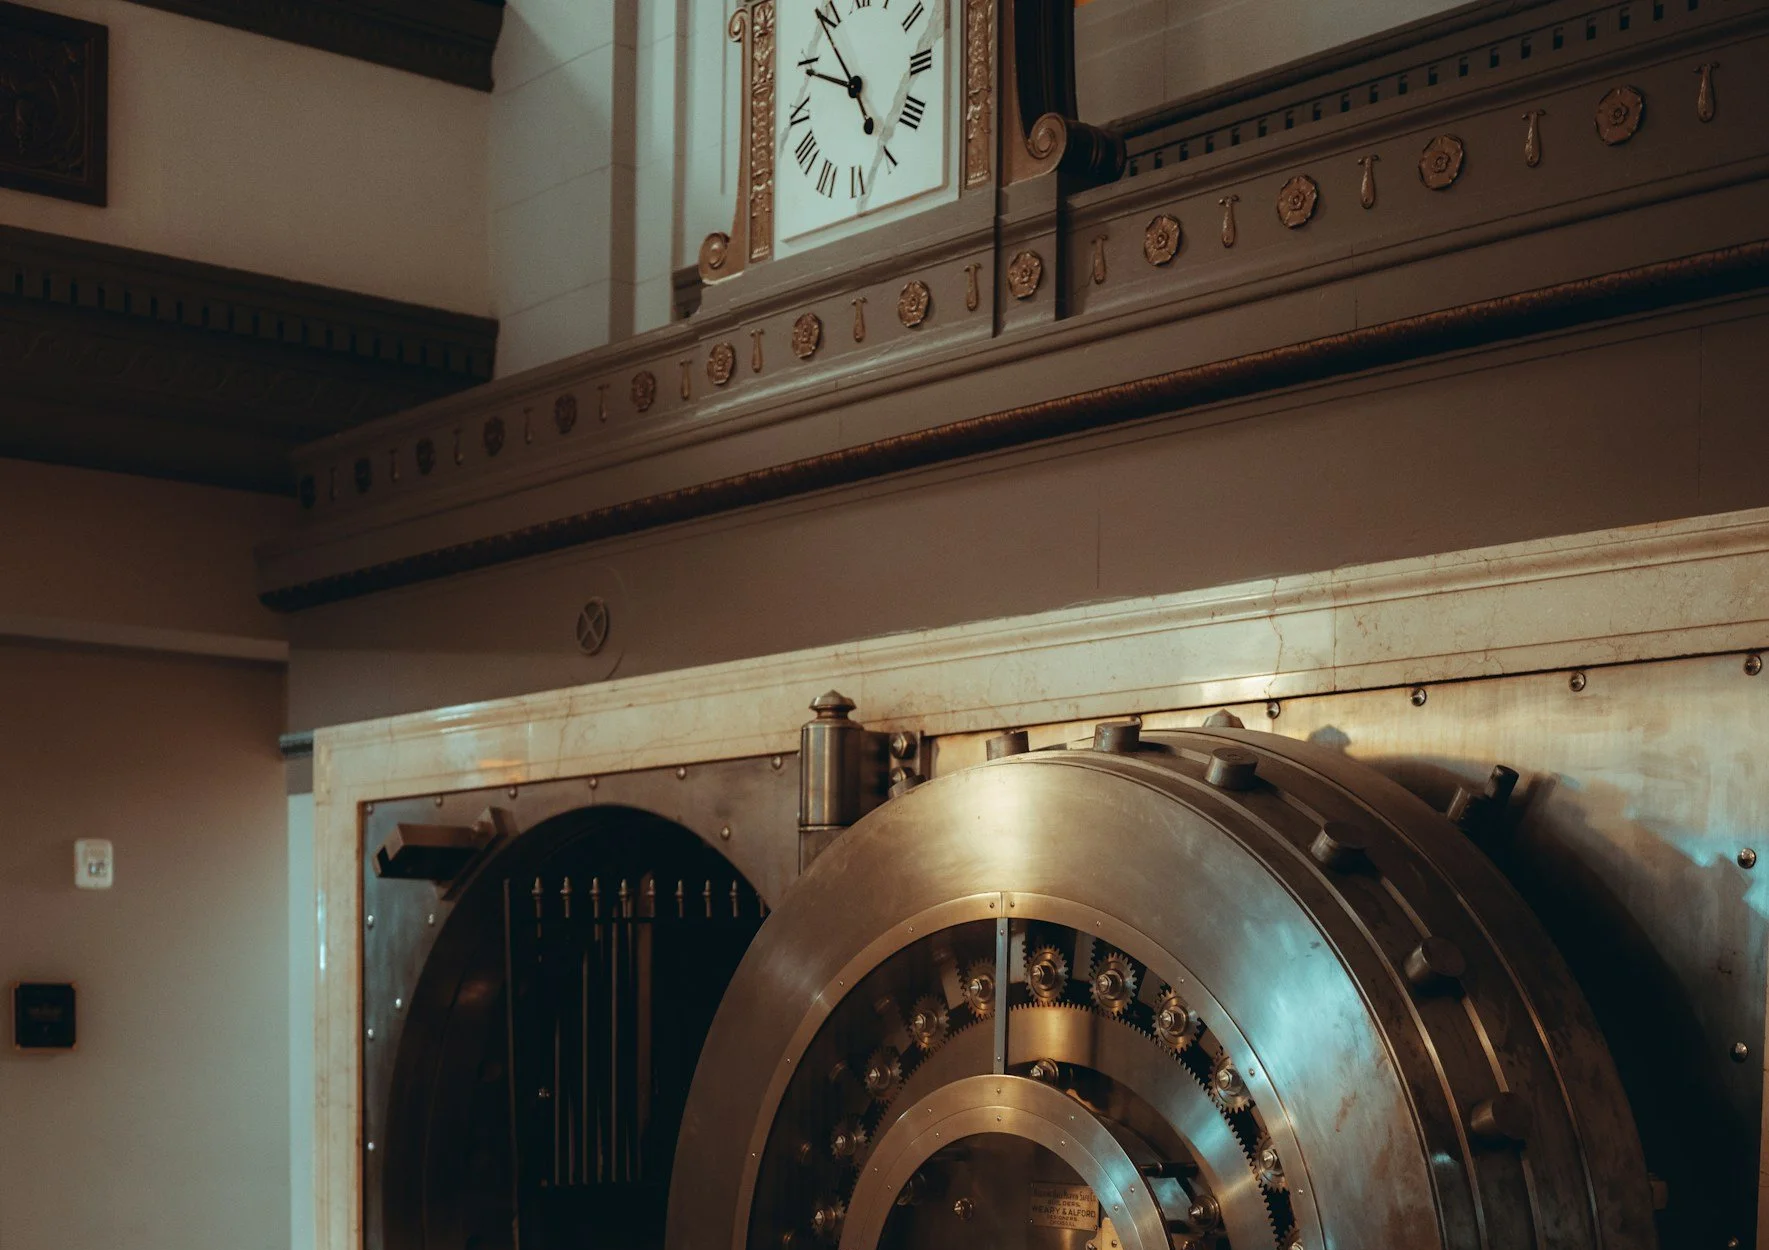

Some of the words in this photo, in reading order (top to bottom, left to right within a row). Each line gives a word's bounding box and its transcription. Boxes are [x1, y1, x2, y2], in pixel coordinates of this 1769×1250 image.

[797, 48, 820, 70] X
[909, 48, 932, 77] III
[882, 144, 898, 175] V
[1031, 1204, 1061, 1214] WEARY
